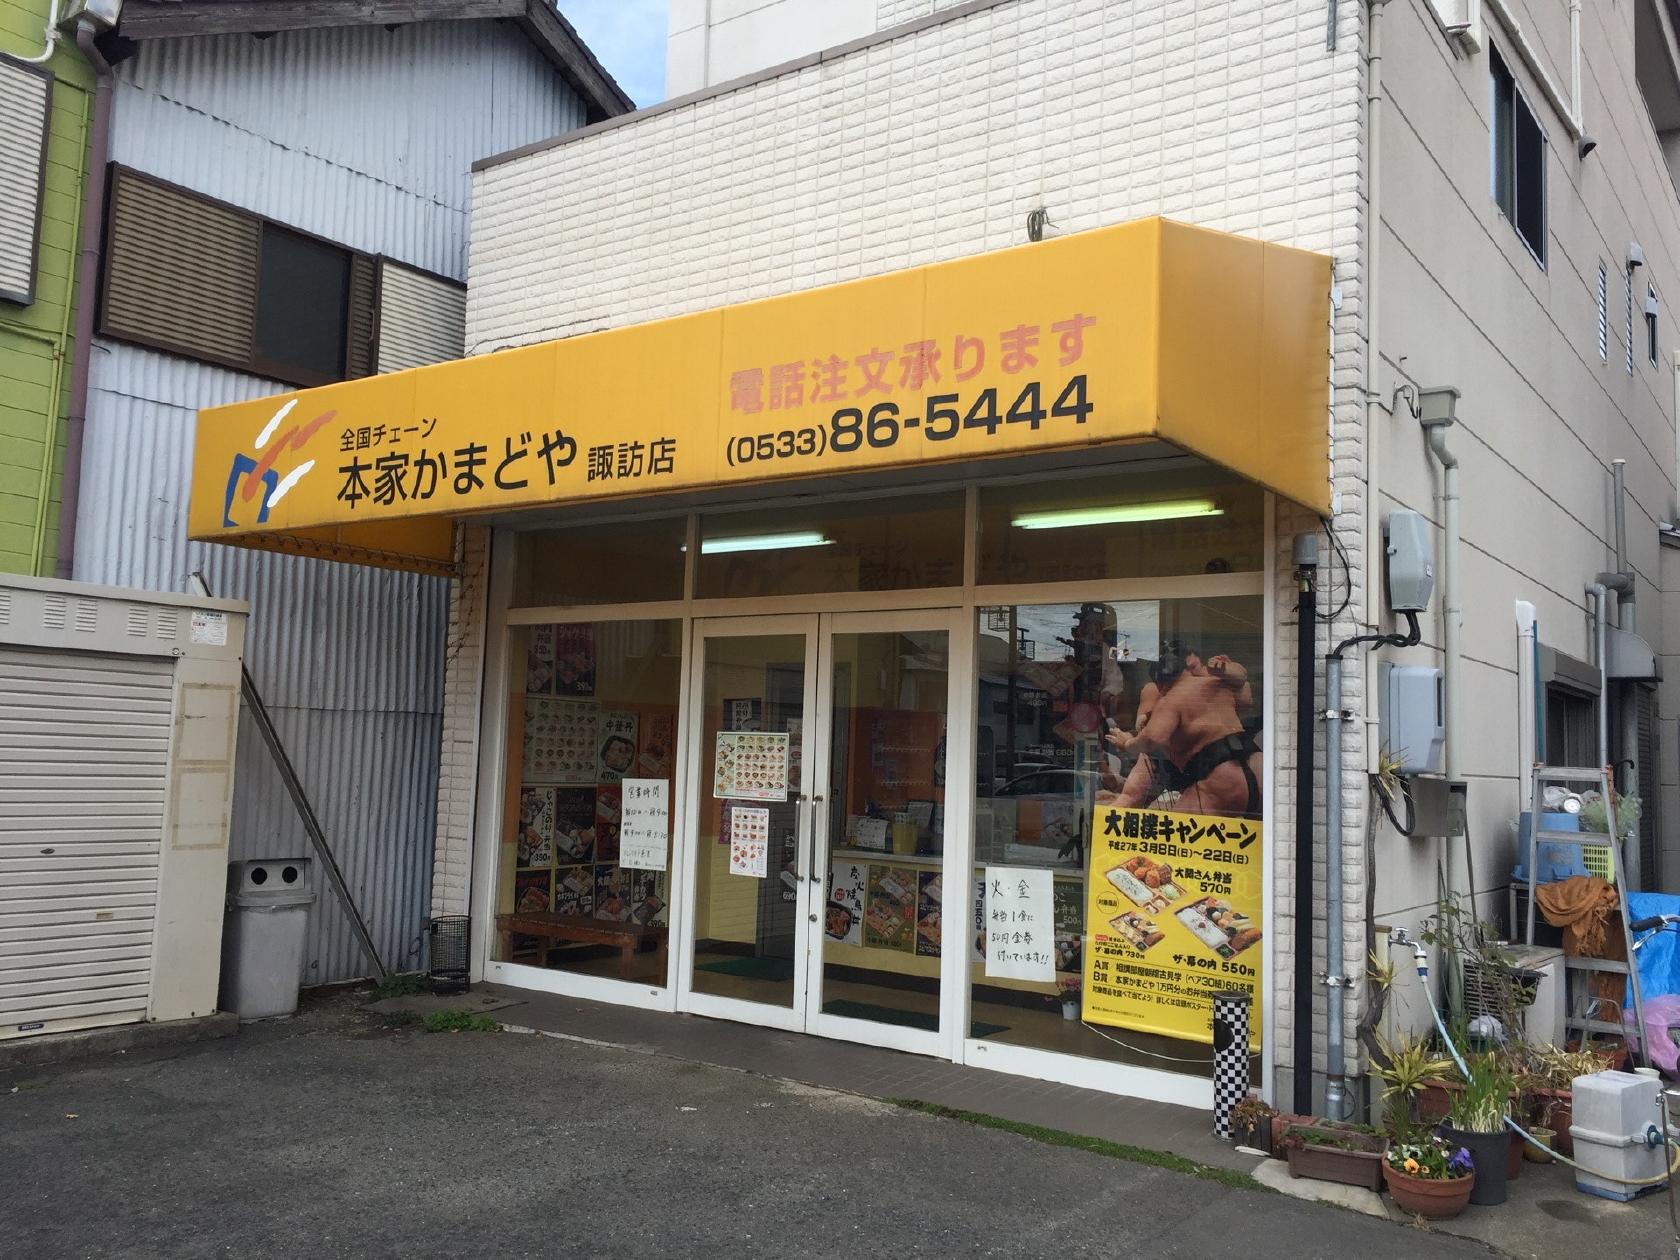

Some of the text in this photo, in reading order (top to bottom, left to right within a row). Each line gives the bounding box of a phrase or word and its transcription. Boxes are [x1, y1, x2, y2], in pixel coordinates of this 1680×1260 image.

[730, 313, 1097, 415] 電話注文承ります
[340, 418, 437, 452] 全国チェーン
[337, 429, 676, 509] 本家かまどや 諏訪店
[1104, 809, 1257, 849] 大相撲キャンペーン
[1174, 867, 1233, 884] 大関さん弁当
[1200, 882, 1232, 895] 570円
[1093, 960, 1109, 971] A賞
[1093, 971, 1109, 983] B賞
[1172, 954, 1256, 977] ザ・幕の内 550円
